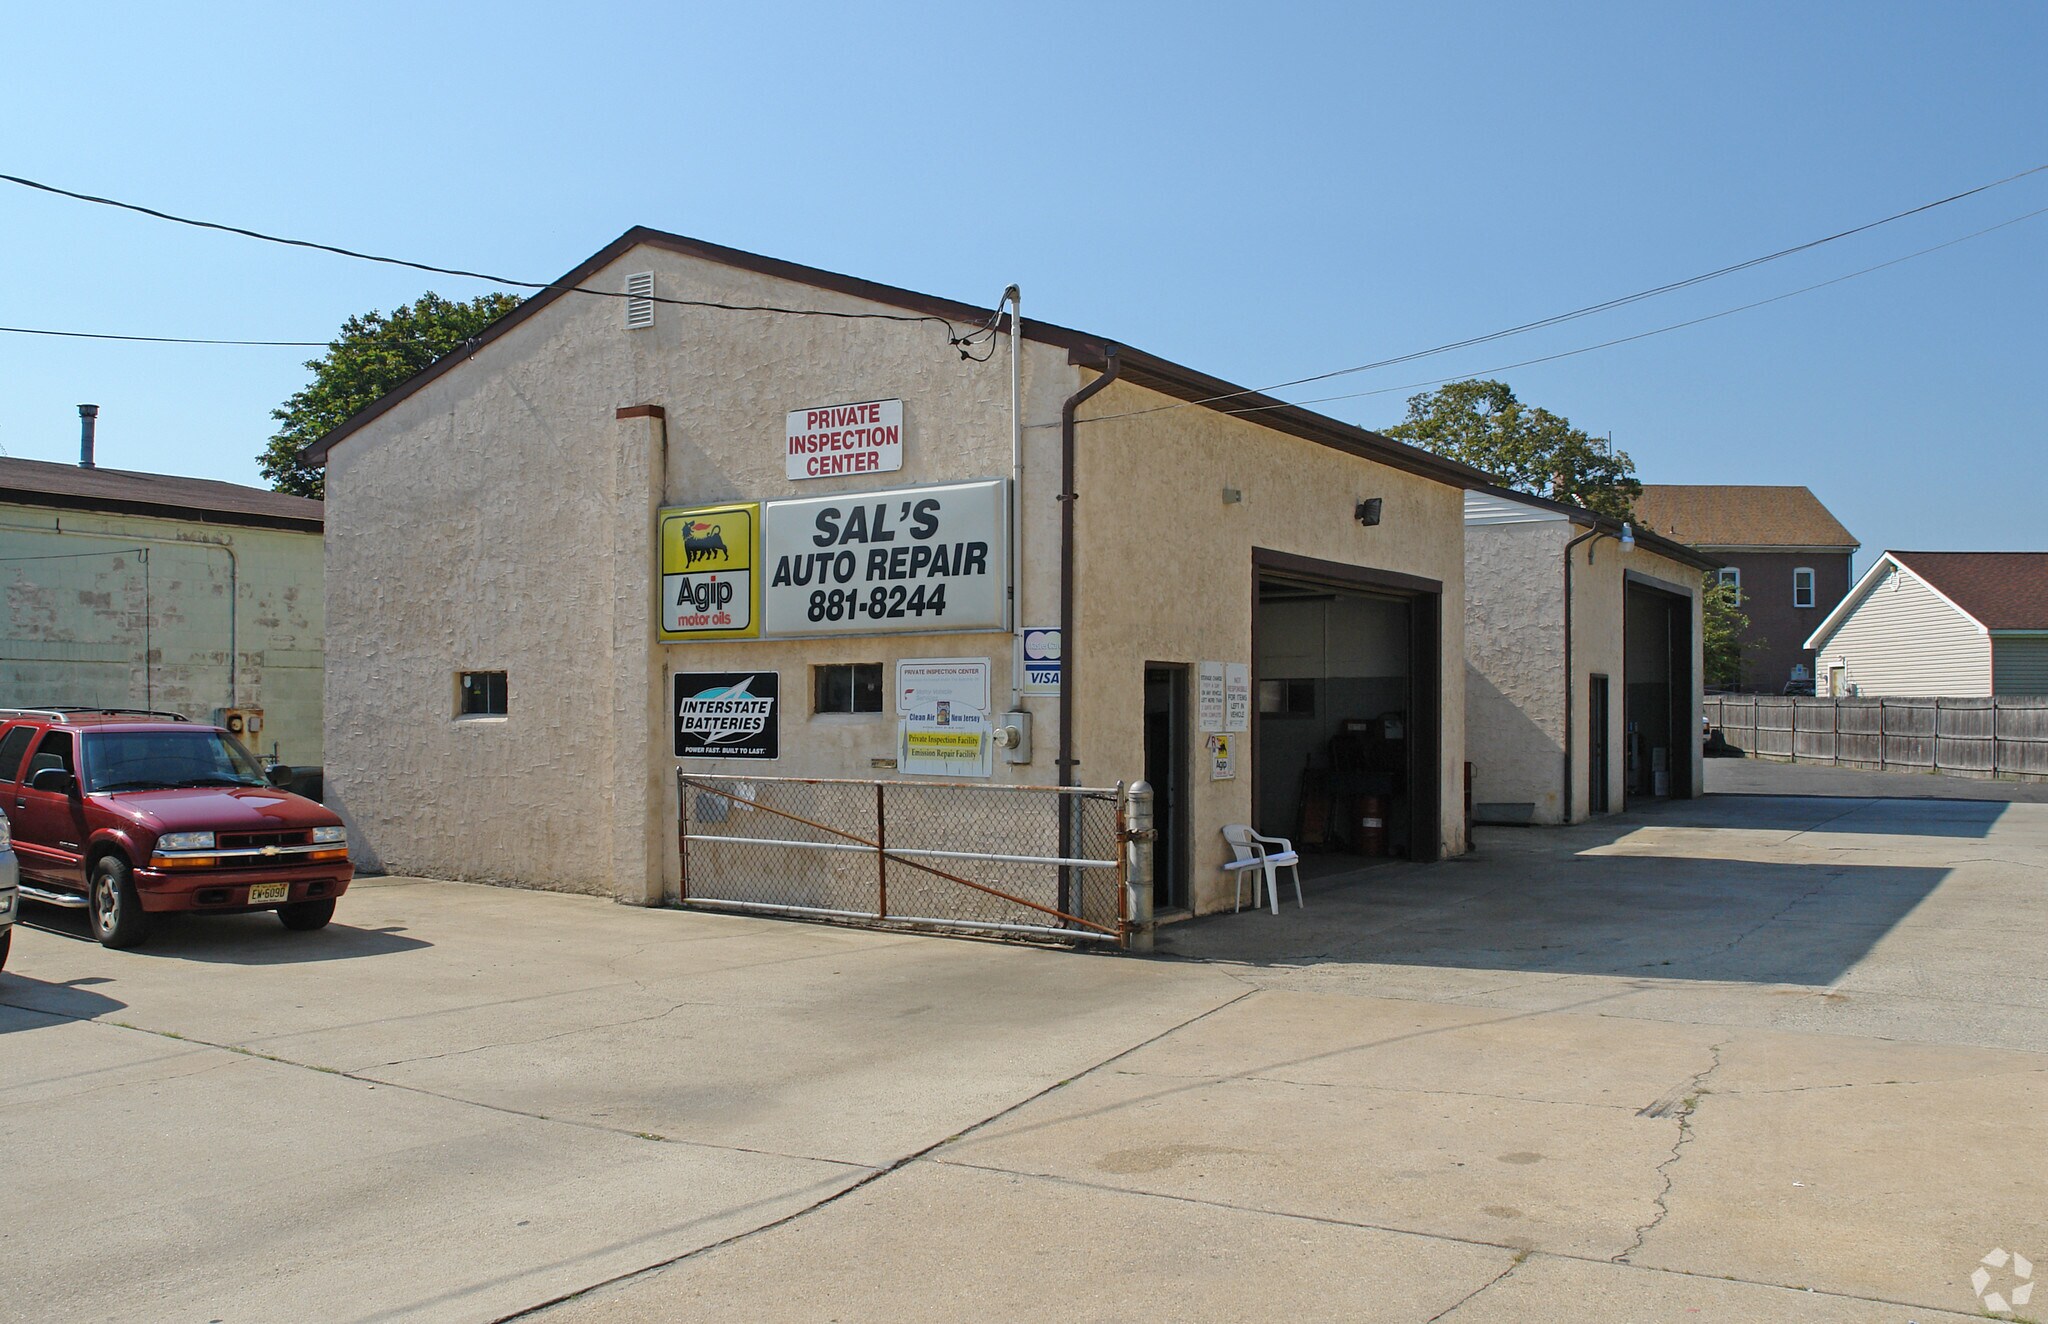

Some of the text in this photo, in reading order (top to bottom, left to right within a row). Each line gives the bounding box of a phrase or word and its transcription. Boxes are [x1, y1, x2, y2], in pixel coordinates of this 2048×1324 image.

[807, 403, 880, 430] PRIVATE
[789, 425, 899, 455] INSPECTION
[806, 451, 880, 476] CENTER
[812, 498, 941, 548] SAL'S
[771, 541, 989, 588] AUTO REPAIR
[676, 575, 733, 612] Agip
[807, 583, 947, 623] 881-8244
[678, 611, 732, 626] motor oils
[1031, 672, 1060, 684] VISA
[682, 701, 769, 714] INTERSTATE
[685, 717, 762, 730] BATTERIES
[909, 713, 980, 723] Clean Air New Jersey
[908, 734, 978, 747] Private Inspection Facility
[685, 746, 705, 754] POWER
[911, 748, 977, 760] Emission Repair Facility
[1215, 759, 1228, 771] Agip
